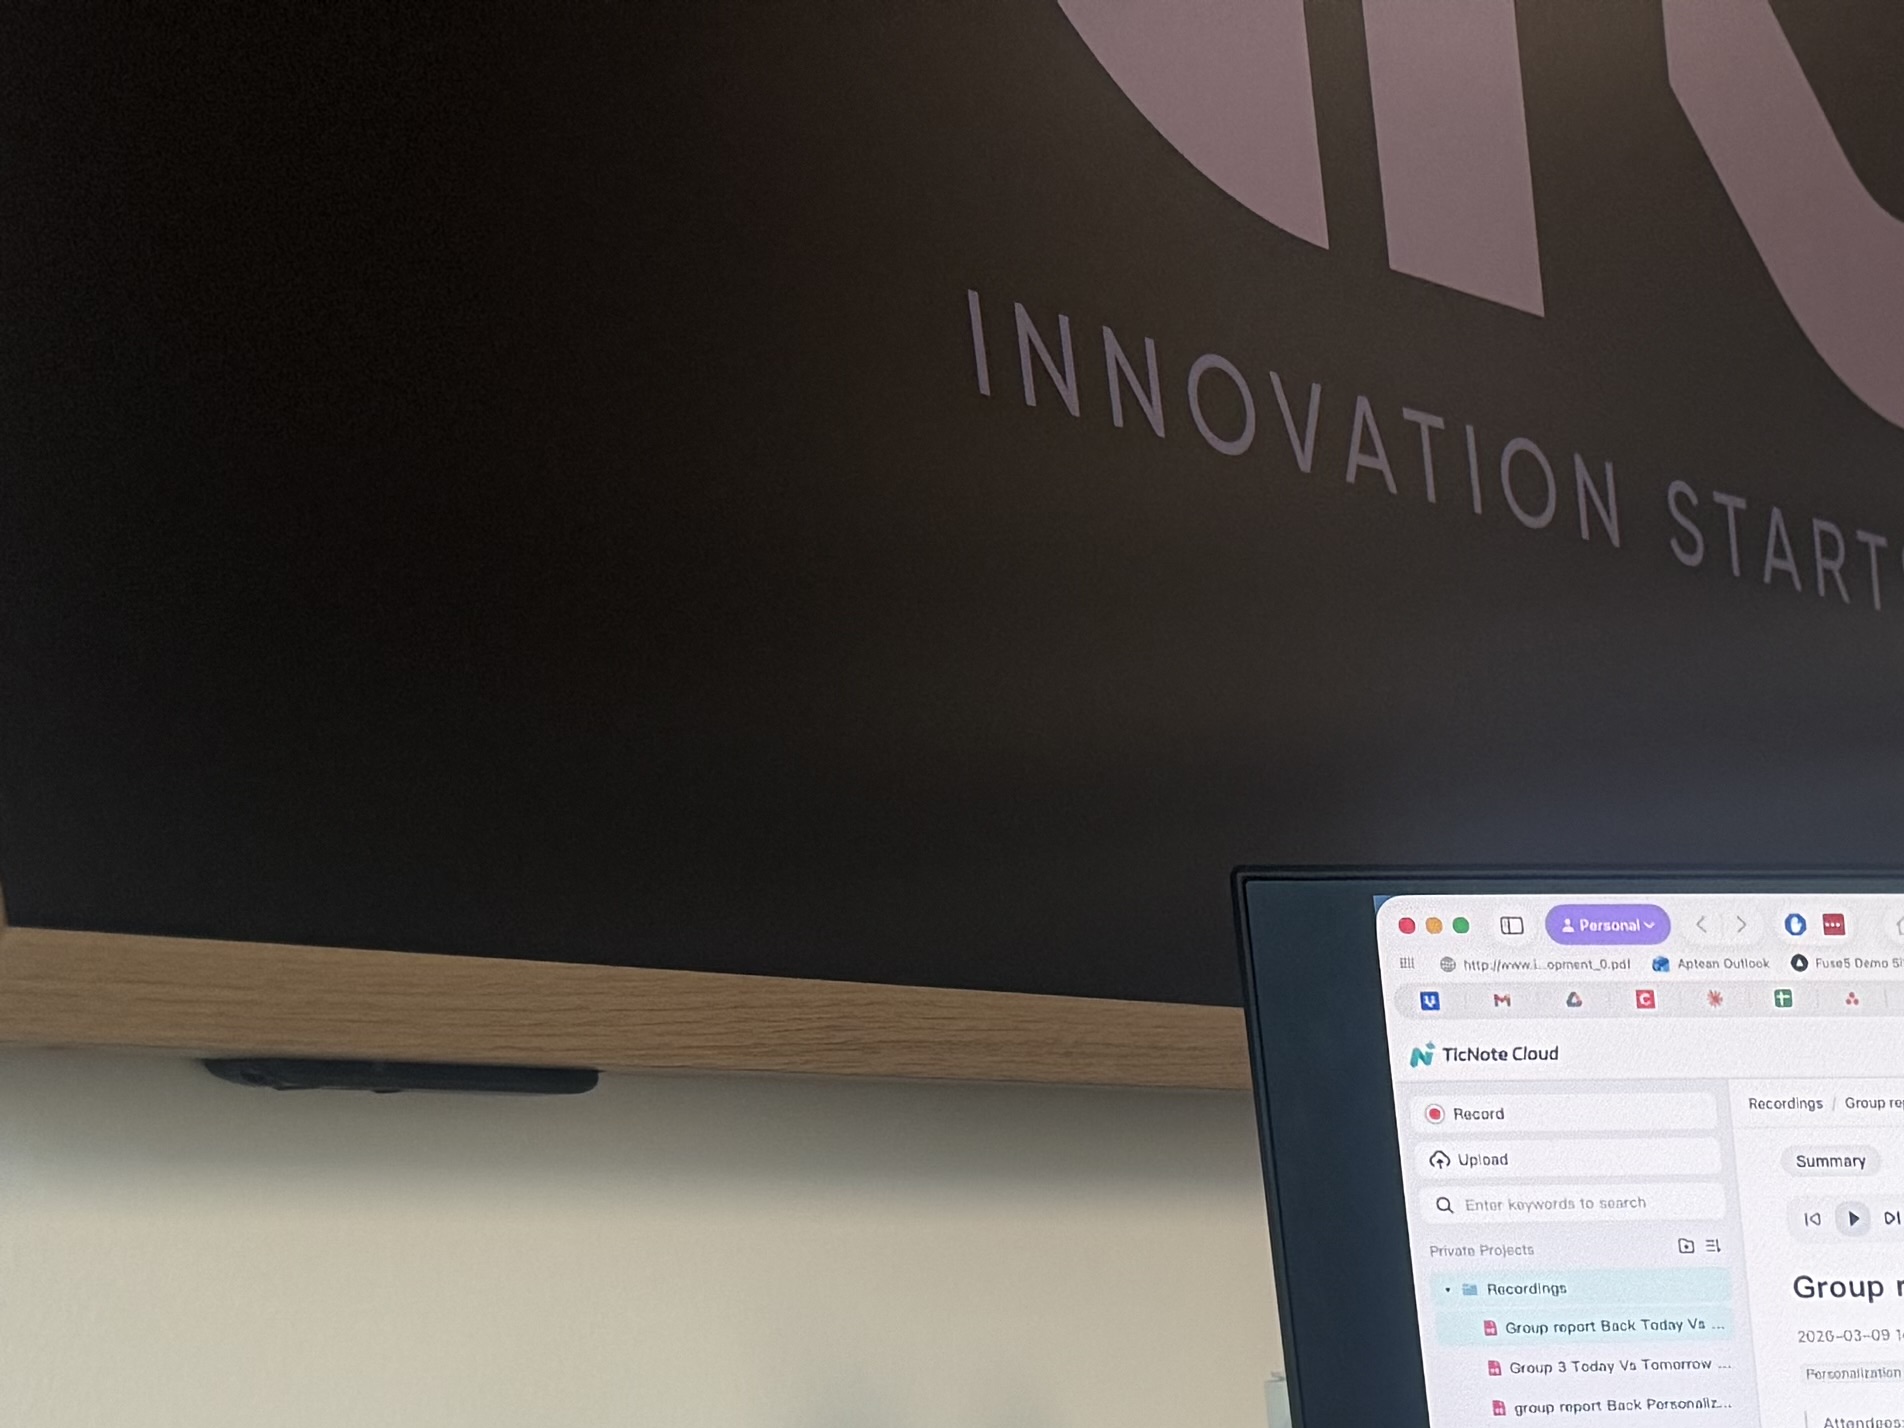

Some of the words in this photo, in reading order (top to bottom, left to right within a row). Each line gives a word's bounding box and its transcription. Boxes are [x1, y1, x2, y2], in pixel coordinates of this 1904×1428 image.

[968, 288, 1620, 548] INNOVATION
[1579, 918, 1641, 932] Personal
[1677, 958, 1720, 971] Aptean
[1723, 957, 1770, 969] Outlook
[1854, 957, 1889, 969] Demo
[1442, 1047, 1508, 1062] TicNote
[1512, 1045, 1559, 1061] Cloud
[1748, 1096, 1824, 1112] Recordings
[1844, 1096, 1886, 1111] Group
[1453, 1107, 1505, 1121] Record
[1458, 1152, 1509, 1169] Upload
[1796, 1154, 1866, 1170] Summary
[1465, 1198, 1503, 1212] Enter
[1507, 1197, 1576, 1214] keywords
[1579, 1198, 1595, 1210] to
[1599, 1196, 1647, 1209] search
[1429, 1245, 1476, 1258] Private
[1479, 1243, 1535, 1259] Projects
[1487, 1282, 1567, 1297] Recordings
[1793, 1275, 1884, 1304] Group
[1797, 1328, 1891, 1343] 2026-03-09
